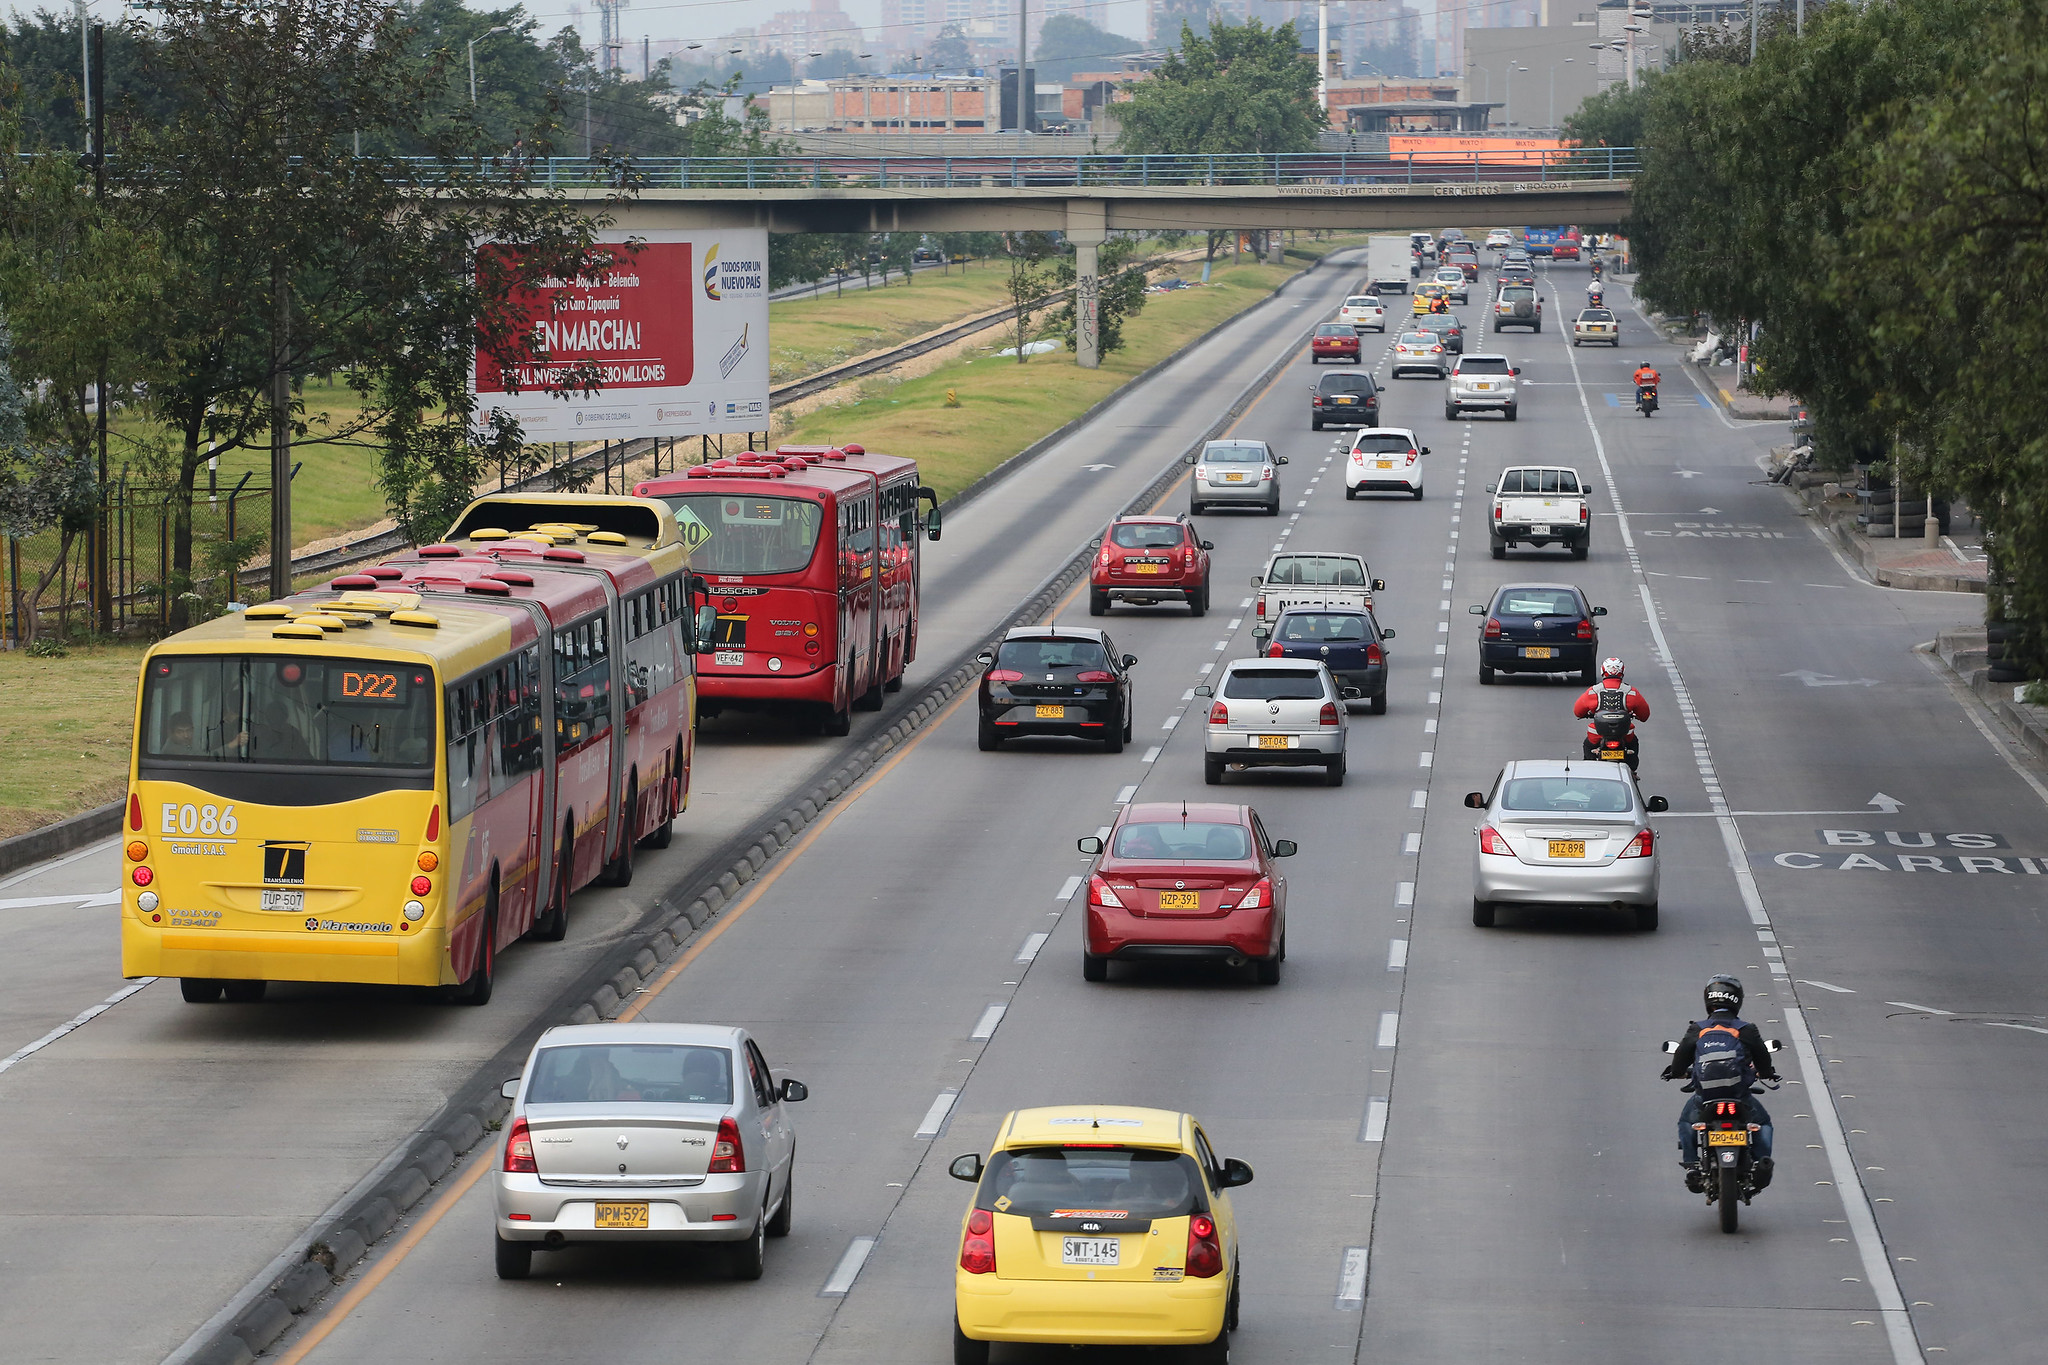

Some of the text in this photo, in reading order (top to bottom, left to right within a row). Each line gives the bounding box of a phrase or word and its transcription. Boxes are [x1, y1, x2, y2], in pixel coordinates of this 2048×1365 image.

[721, 260, 761, 273] TODOS POR UN
[608, 271, 640, 288] Belencito
[721, 273, 761, 290] NUEVO PAÍS
[586, 295, 620, 314] Zipaquirá
[536, 319, 641, 352] EN MARCHA!
[622, 364, 666, 383] MILLONES
[611, 412, 631, 421] COLOMBIA
[342, 671, 398, 699] D22
[161, 802, 238, 836] E086
[1822, 829, 1998, 850] BUS
[171, 843, 201, 855] Gmóvil
[1773, 852, 2048, 875] CARRI
[264, 877, 304, 885] TRANSMILENIO
[166, 908, 223, 919] VOLVO
[320, 920, 393, 933] Marcopolo
[1082, 1221, 1101, 1231] KIA
